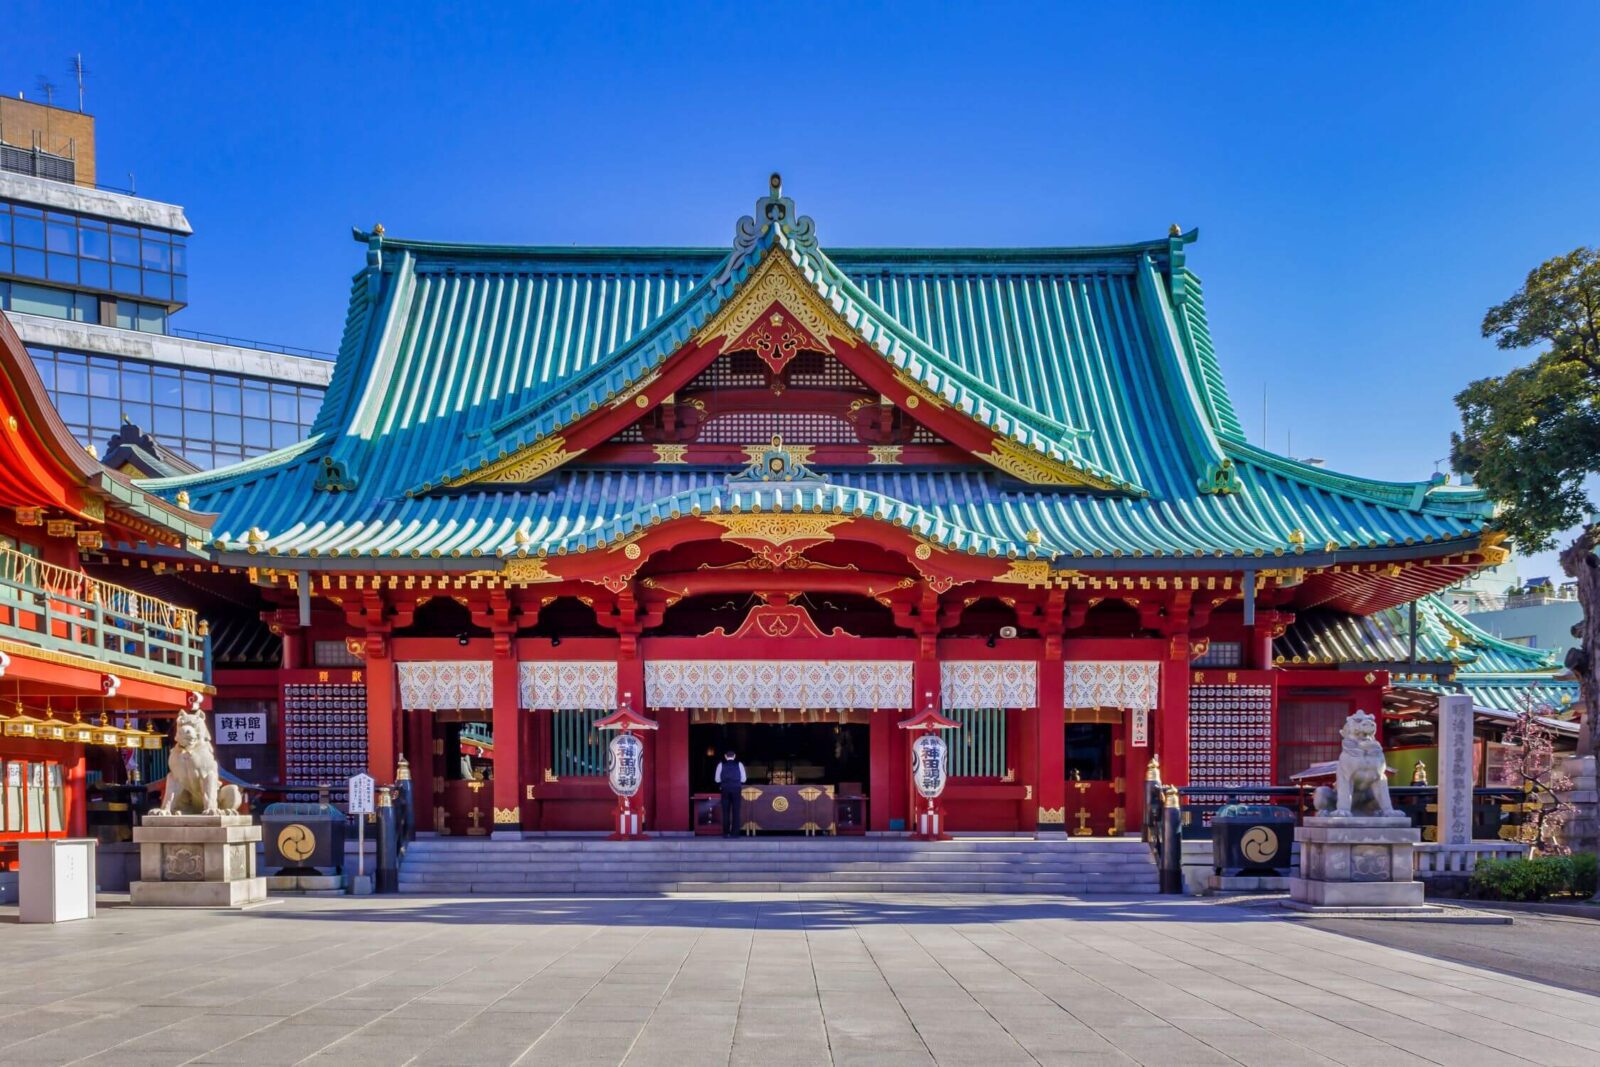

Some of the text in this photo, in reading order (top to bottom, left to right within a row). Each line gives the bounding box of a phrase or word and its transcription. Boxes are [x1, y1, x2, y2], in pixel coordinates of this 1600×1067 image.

[221, 716, 261, 730] 資料館
[227, 730, 255, 742] 受付
[617, 745, 637, 788] 神田明神
[920, 746, 941, 790] 神田明神
